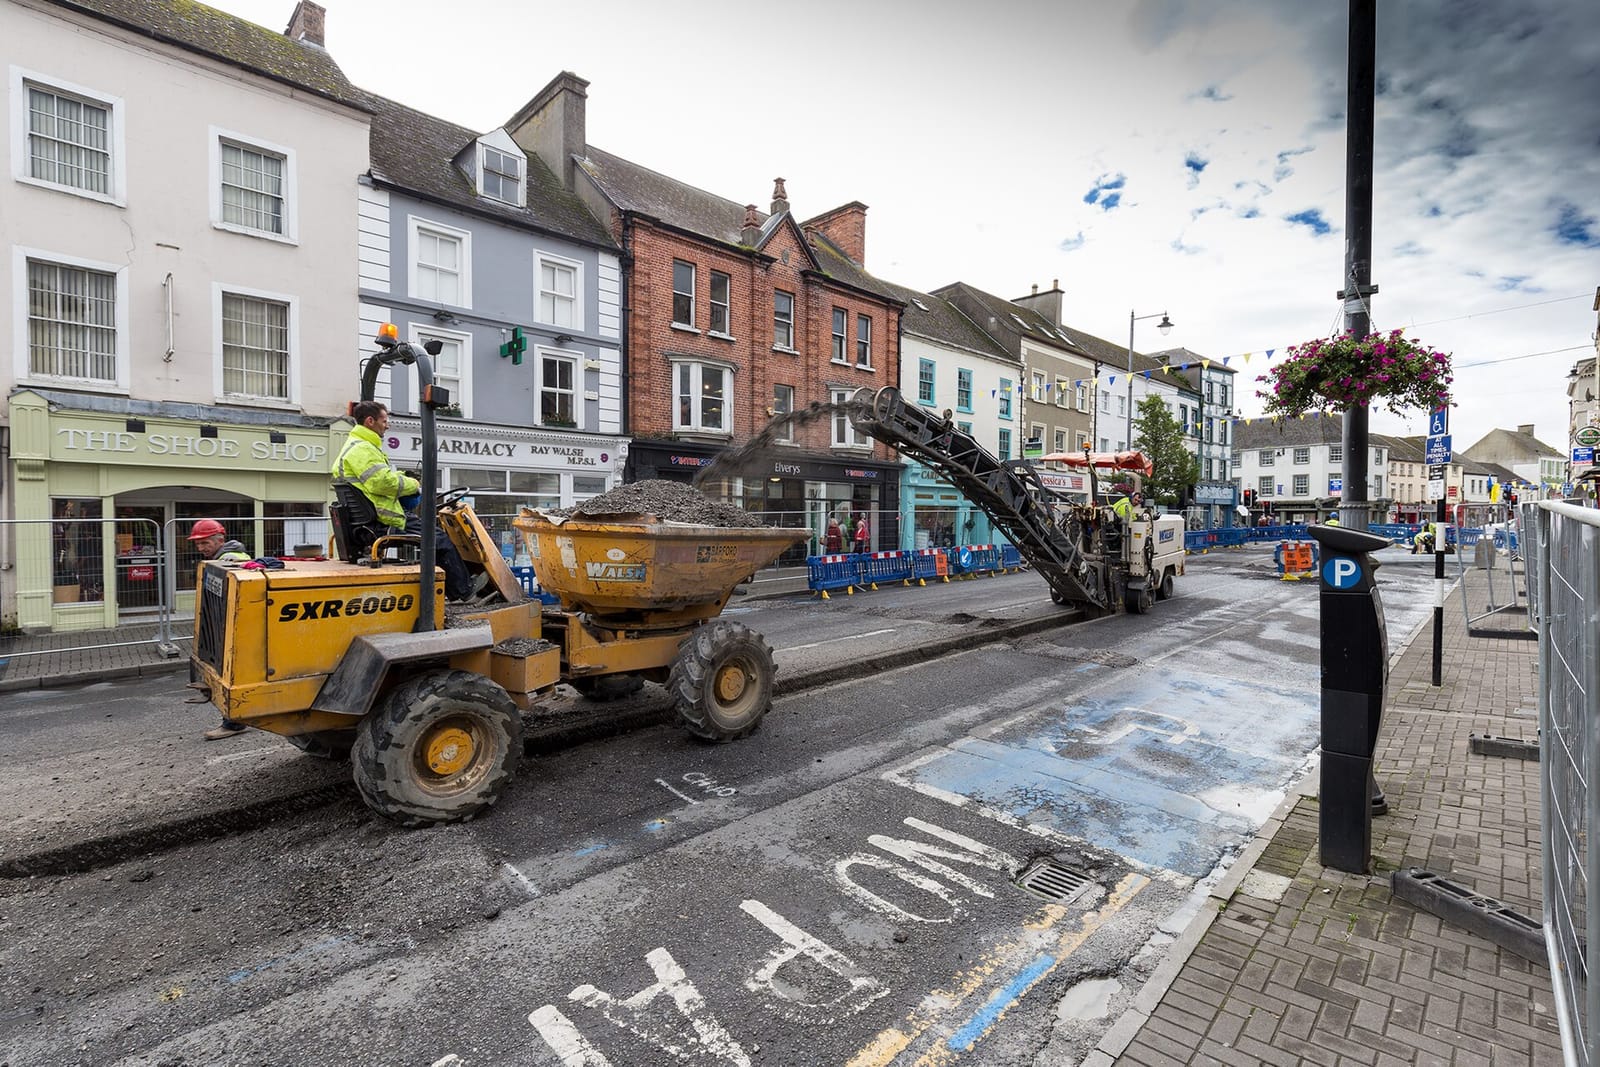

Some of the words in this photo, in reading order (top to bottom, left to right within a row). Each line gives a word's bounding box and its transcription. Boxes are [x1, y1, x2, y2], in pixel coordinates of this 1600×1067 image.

[57, 428, 137, 452] THE
[147, 434, 241, 458] SHOE
[251, 440, 327, 463] SHOP
[411, 437, 517, 457] PARMACY
[531, 445, 550, 455] RAY
[552, 446, 584, 457] WALSH
[775, 463, 801, 475] Elverys
[1040, 475, 1066, 487] Jessica's
[586, 562, 646, 578] WALSH
[1335, 559, 1356, 587] P
[833, 817, 1019, 924] NO
